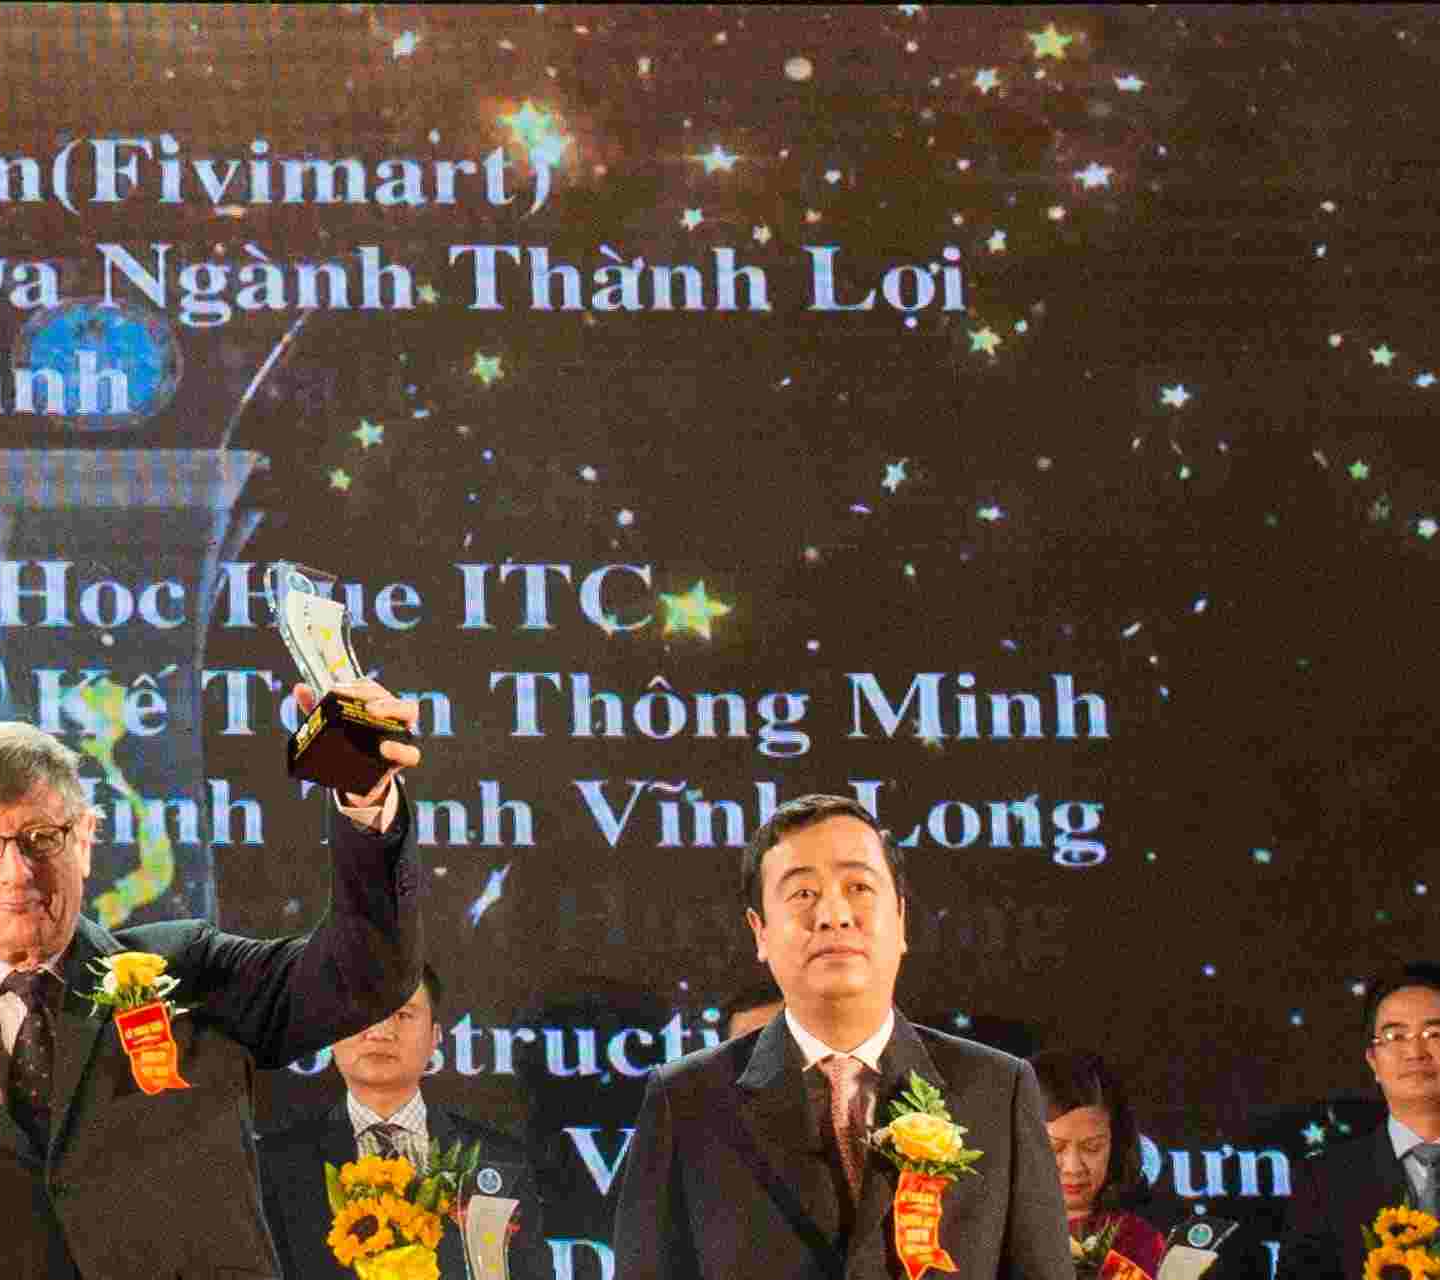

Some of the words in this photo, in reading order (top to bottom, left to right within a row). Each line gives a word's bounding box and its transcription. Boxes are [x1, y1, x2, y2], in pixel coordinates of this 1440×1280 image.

[97, 242, 420, 327] Ngành
[448, 243, 772, 312] Thành
[802, 245, 968, 328] Lợi
[450, 562, 655, 632] ITC
[489, 670, 810, 757] Thông
[846, 670, 1110, 740] Minh
